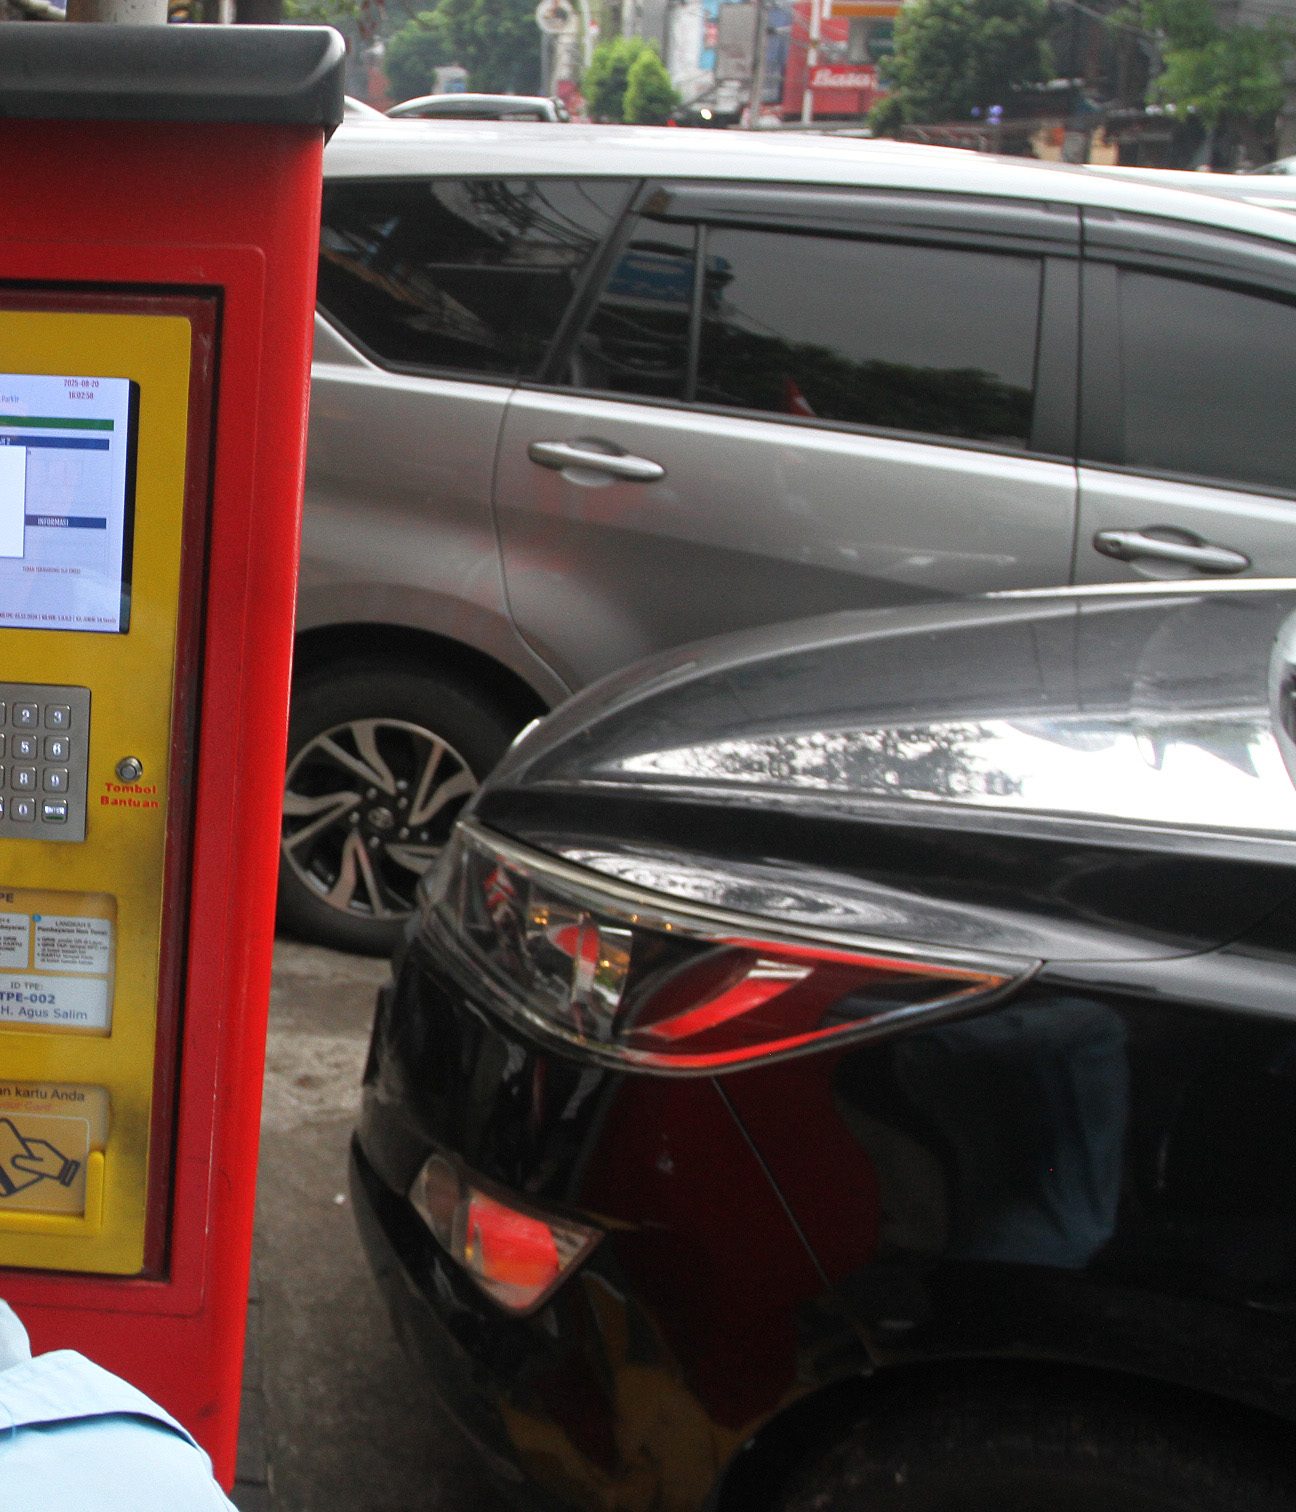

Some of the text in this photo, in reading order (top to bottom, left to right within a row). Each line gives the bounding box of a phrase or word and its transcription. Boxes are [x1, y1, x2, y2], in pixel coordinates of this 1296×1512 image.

[37, 518, 69, 526] INFORMASI
[22, 709, 30, 723] 2
[54, 710, 62, 724] 3
[21, 741, 30, 753] 5
[52, 742, 62, 755] 6
[19, 772, 28, 785] 8
[51, 774, 60, 787] 9
[105, 782, 156, 794] Tombol
[100, 796, 159, 809] Bantuan
[44, 805, 65, 815] ENTER
[10, 981, 44, 991] ID TPE:
[0, 1005, 14, 1016] H.
[18, 1006, 49, 1019] Agus
[53, 1008, 88, 1020] Salim
[15, 1086, 47, 1100] kartu
[51, 1089, 85, 1101] Anda
